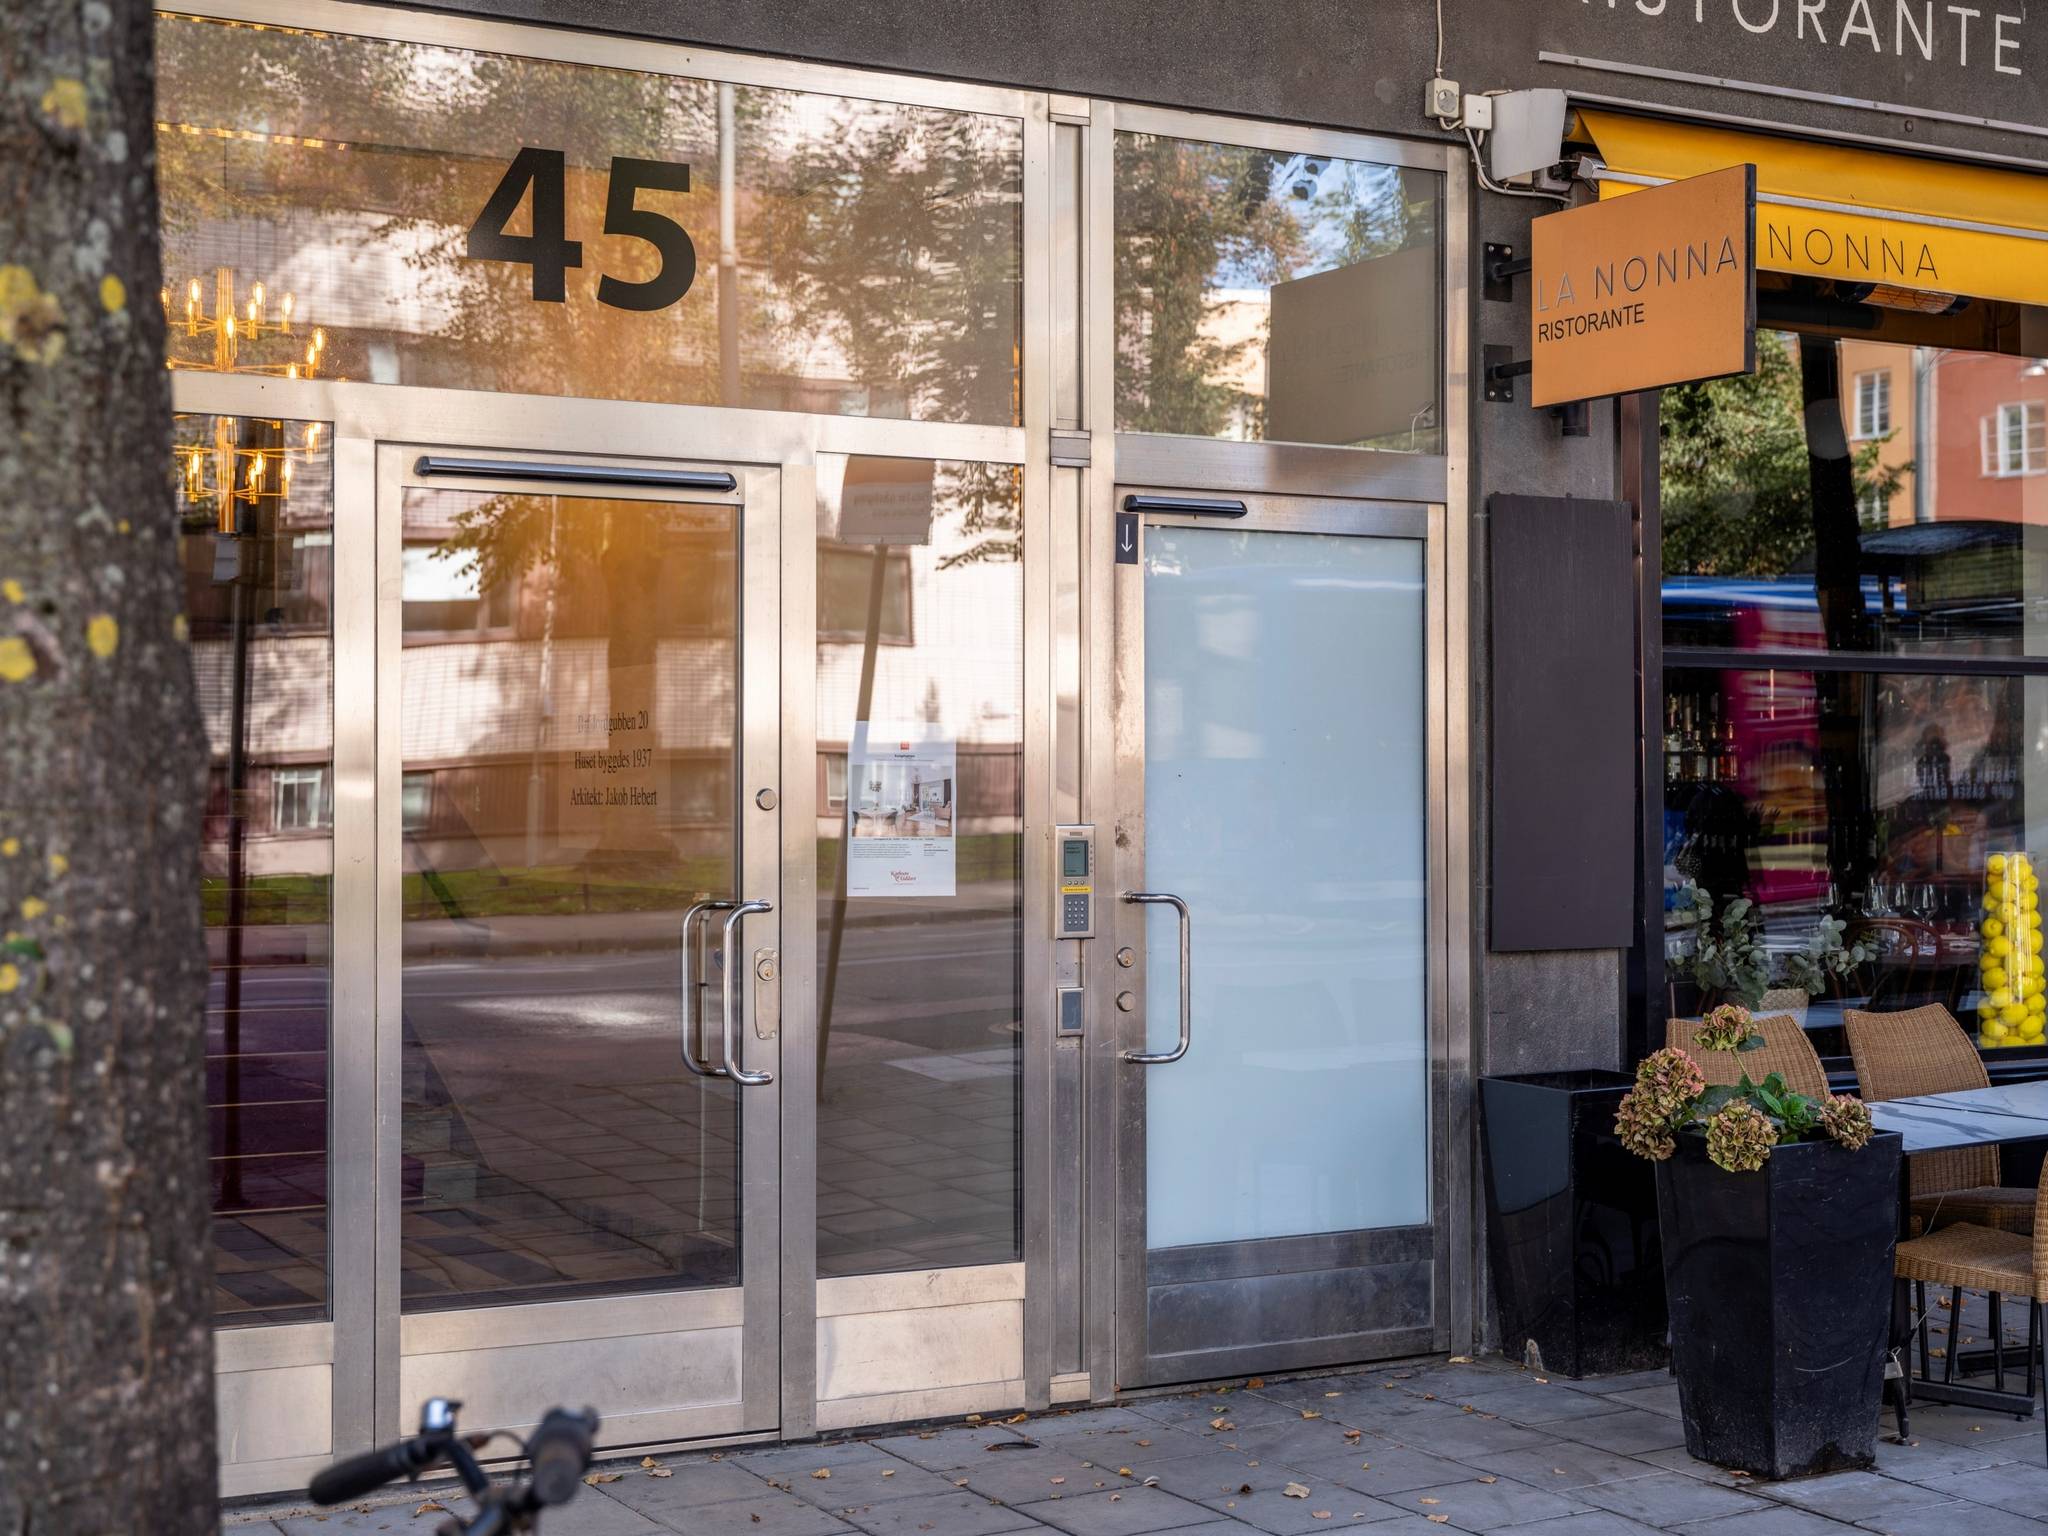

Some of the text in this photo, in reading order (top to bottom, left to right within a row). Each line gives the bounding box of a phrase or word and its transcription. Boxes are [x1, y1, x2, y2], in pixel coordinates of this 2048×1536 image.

[1583, 0, 2022, 76] ORANTE
[466, 147, 697, 311] 45
[1767, 222, 1939, 281] NONNA
[1537, 235, 1738, 312] LA NONNA
[1538, 302, 1646, 343] RISTORANTE
[638, 710, 649, 730] 20
[574, 751, 596, 769] Huset
[633, 748, 652, 768] 1937
[570, 787, 657, 805] Arkitekt: Jakob Hebert
